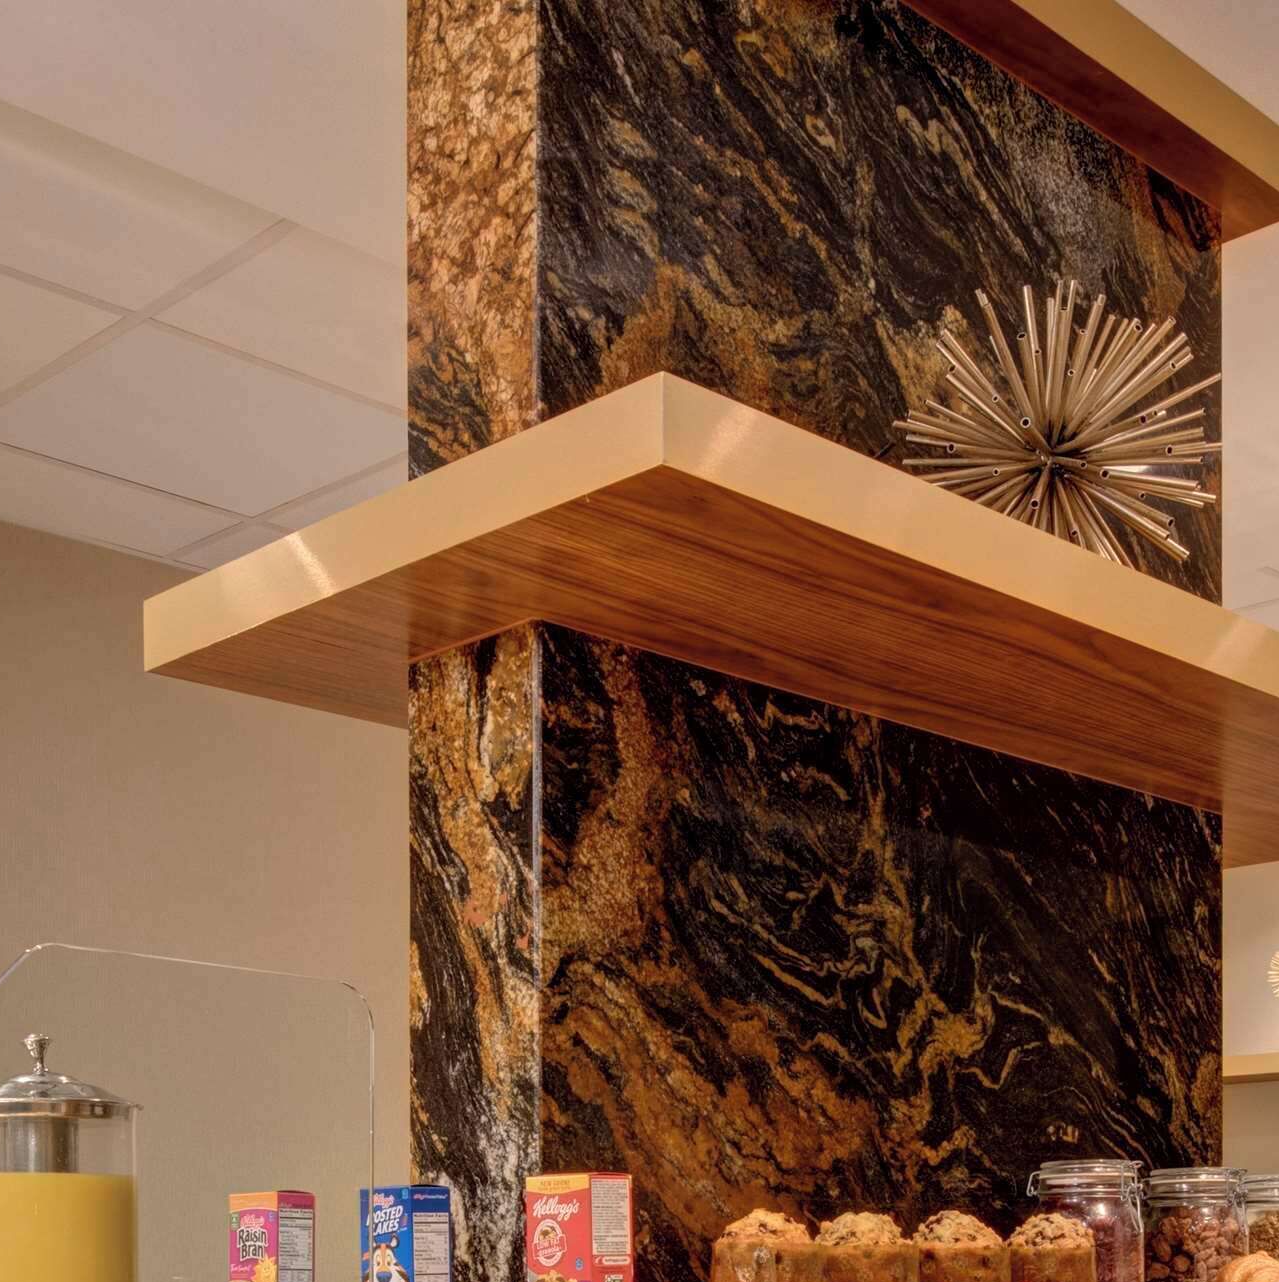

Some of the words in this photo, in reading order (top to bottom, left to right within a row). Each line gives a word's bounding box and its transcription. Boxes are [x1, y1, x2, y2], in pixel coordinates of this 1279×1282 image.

[366, 1205, 403, 1226] OSTED
[533, 1195, 580, 1221] Kellogg's
[372, 1218, 400, 1236] AKES
[238, 1228, 268, 1246] Raisin
[241, 1243, 265, 1260] Bran
